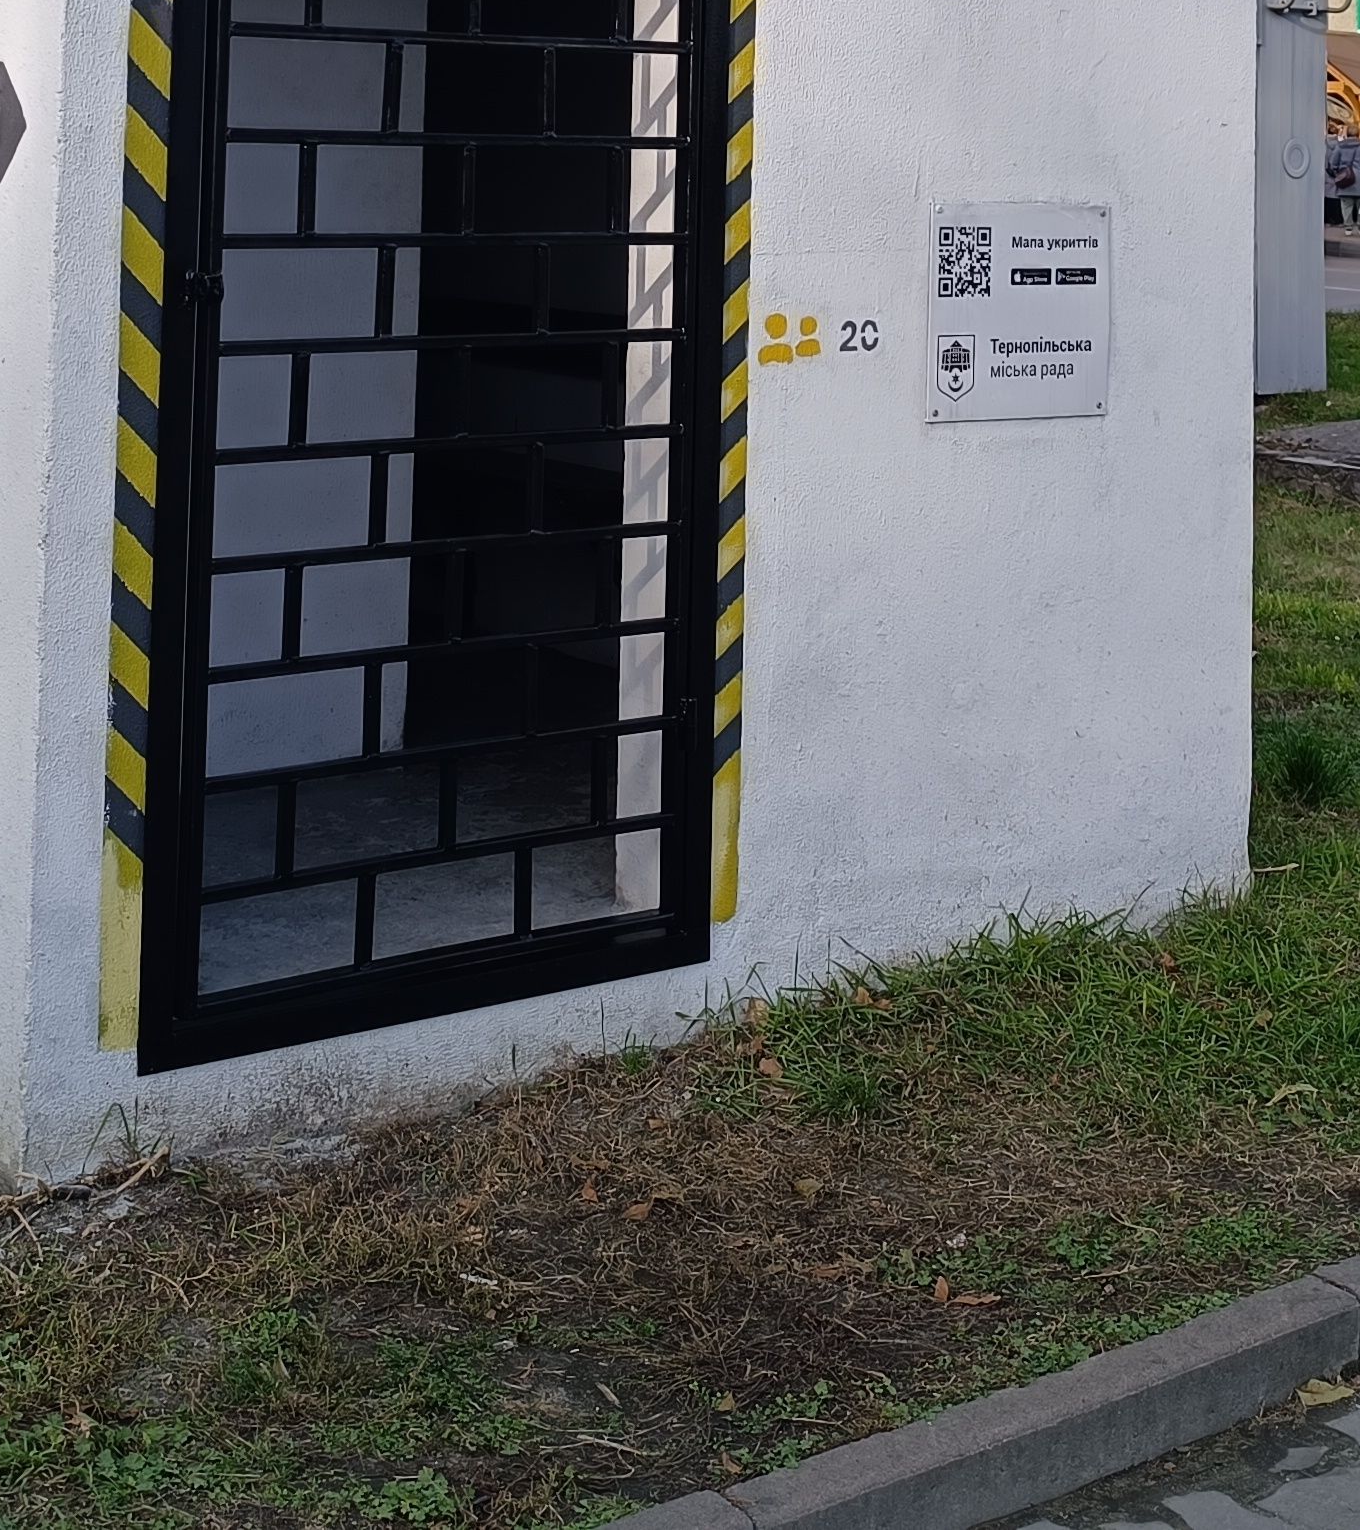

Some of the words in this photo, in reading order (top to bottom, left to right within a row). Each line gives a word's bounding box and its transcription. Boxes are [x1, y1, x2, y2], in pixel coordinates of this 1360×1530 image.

[1011, 236, 1044, 249] Мапа
[1047, 235, 1099, 251] укриттів
[839, 319, 879, 352] 20
[990, 336, 1092, 358] Тернопільська
[990, 360, 1037, 378] міська
[1040, 363, 1074, 380] рада
